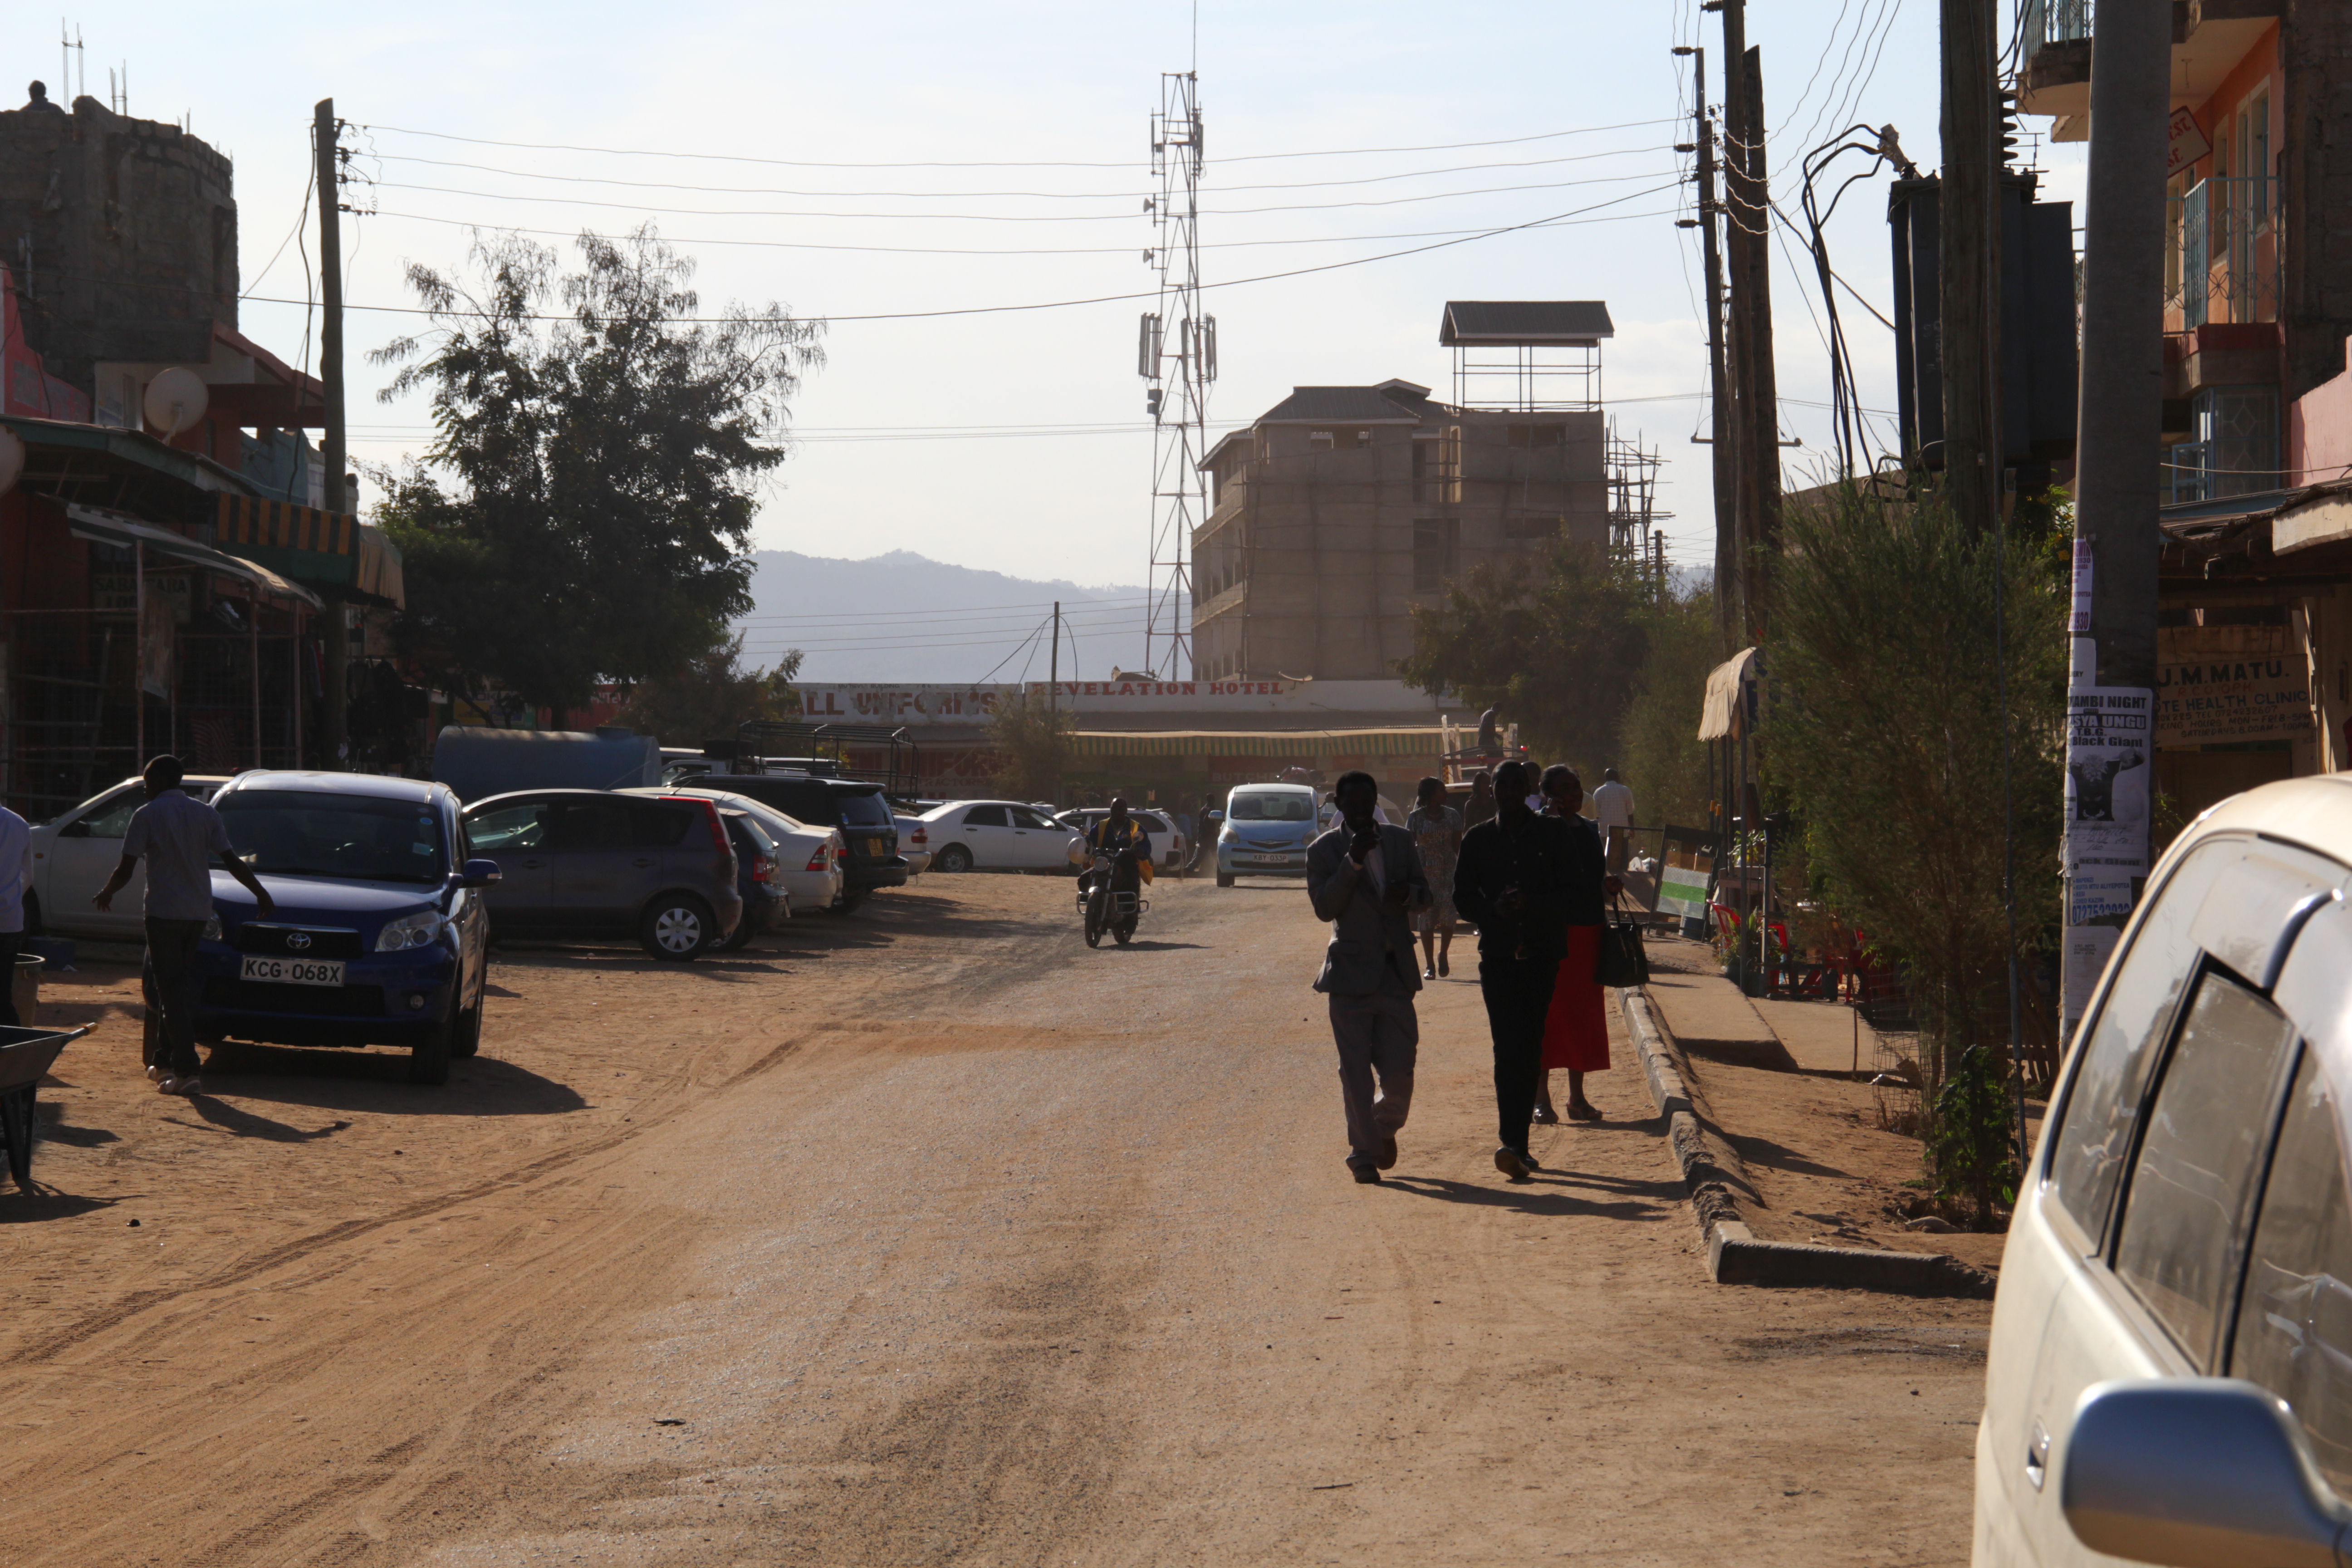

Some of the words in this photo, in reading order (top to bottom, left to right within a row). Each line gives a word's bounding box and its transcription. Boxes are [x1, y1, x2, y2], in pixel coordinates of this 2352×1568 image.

[1033, 683, 1196, 695] REVELATION
[1210, 682, 1284, 695] HOTEL
[2107, 696, 2146, 709] NIGHT
[2185, 695, 2246, 710] HEALTH
[2254, 691, 2307, 704] CLINIC
[2171, 712, 2191, 721] 225
[2215, 705, 2277, 717] 0724232607
[2102, 715, 2145, 729] UNGU
[2190, 719, 2222, 727] HOURS
[2181, 727, 2235, 737] SATURDAYS
[2073, 736, 2105, 745] Black
[2108, 737, 2142, 747] Giant
